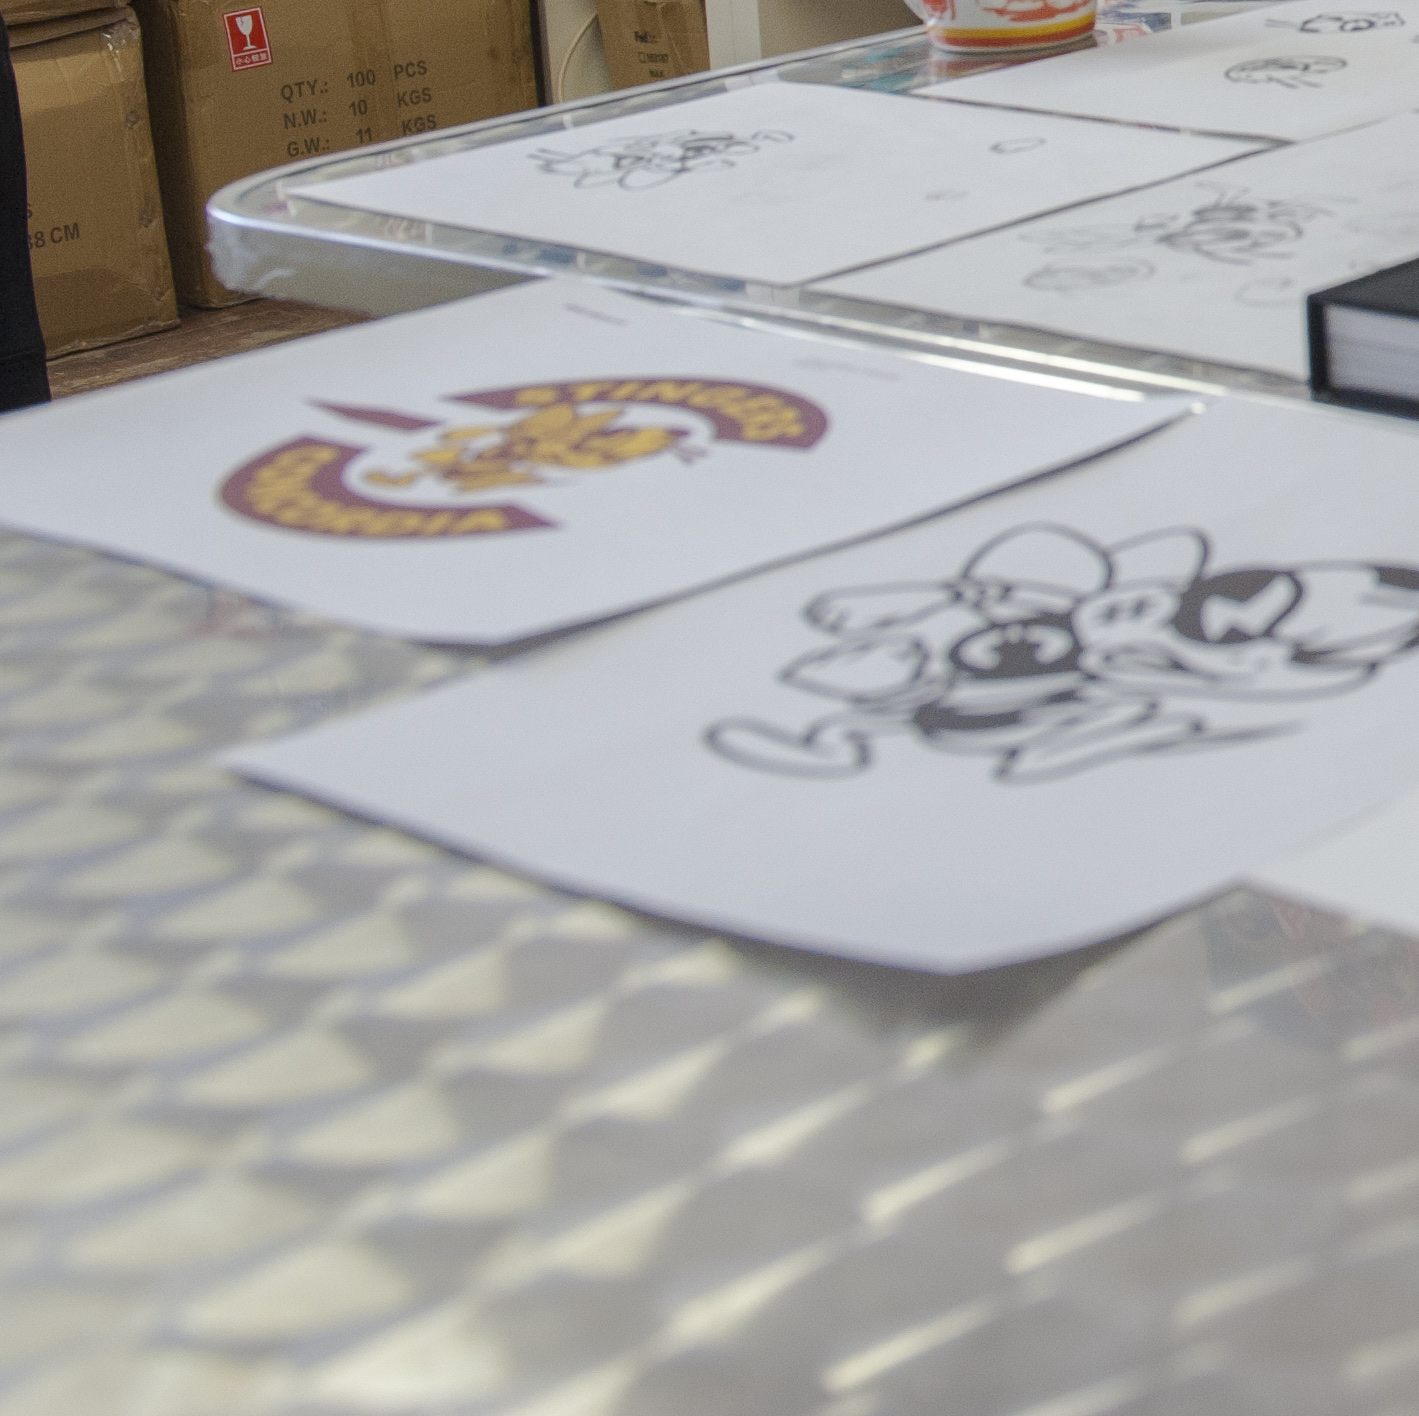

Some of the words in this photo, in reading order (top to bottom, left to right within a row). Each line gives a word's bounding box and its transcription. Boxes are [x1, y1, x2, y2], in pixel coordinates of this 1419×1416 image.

[281, 79, 329, 103] QTY.:
[347, 70, 376, 88] 100
[393, 60, 427, 79] PCS
[284, 109, 327, 129] N.W.:
[350, 100, 368, 116] 10
[396, 88, 432, 108] KGS
[287, 137, 330, 157] G.W.:
[356, 127, 373, 144] 11
[401, 114, 437, 135] KGS
[50, 222, 80, 244] CM
